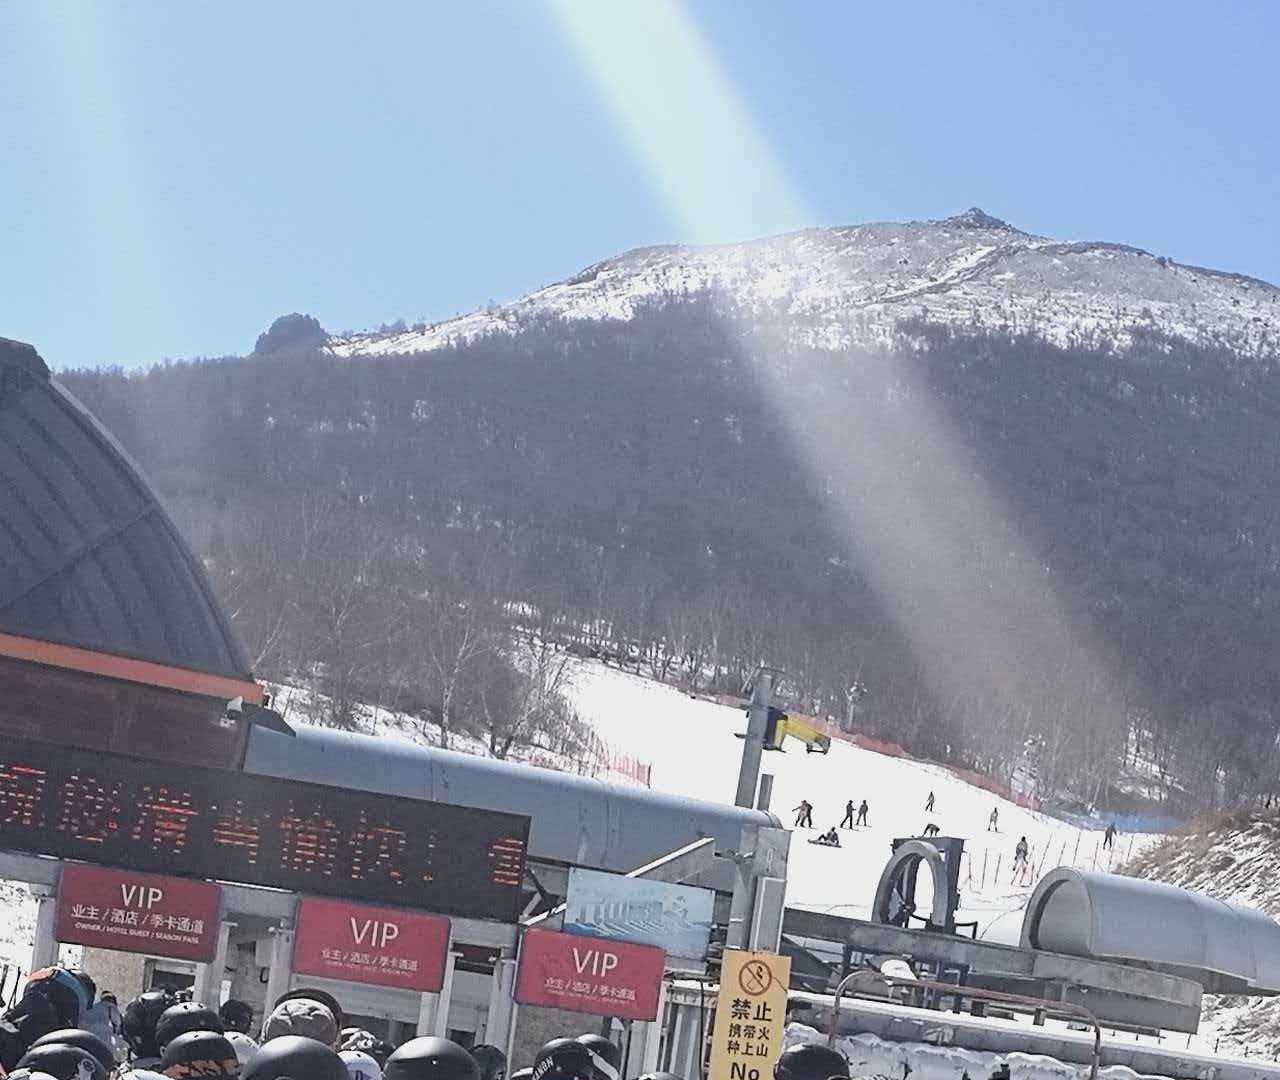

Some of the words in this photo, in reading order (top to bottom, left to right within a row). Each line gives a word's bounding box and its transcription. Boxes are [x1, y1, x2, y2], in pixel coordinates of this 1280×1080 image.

[121, 884, 162, 908] VIP
[351, 917, 399, 948] VIP
[573, 947, 618, 977] VIP
[731, 998, 772, 1022] 禁止
[728, 1023, 770, 1040] 携带火
[728, 1041, 768, 1057] 种上山
